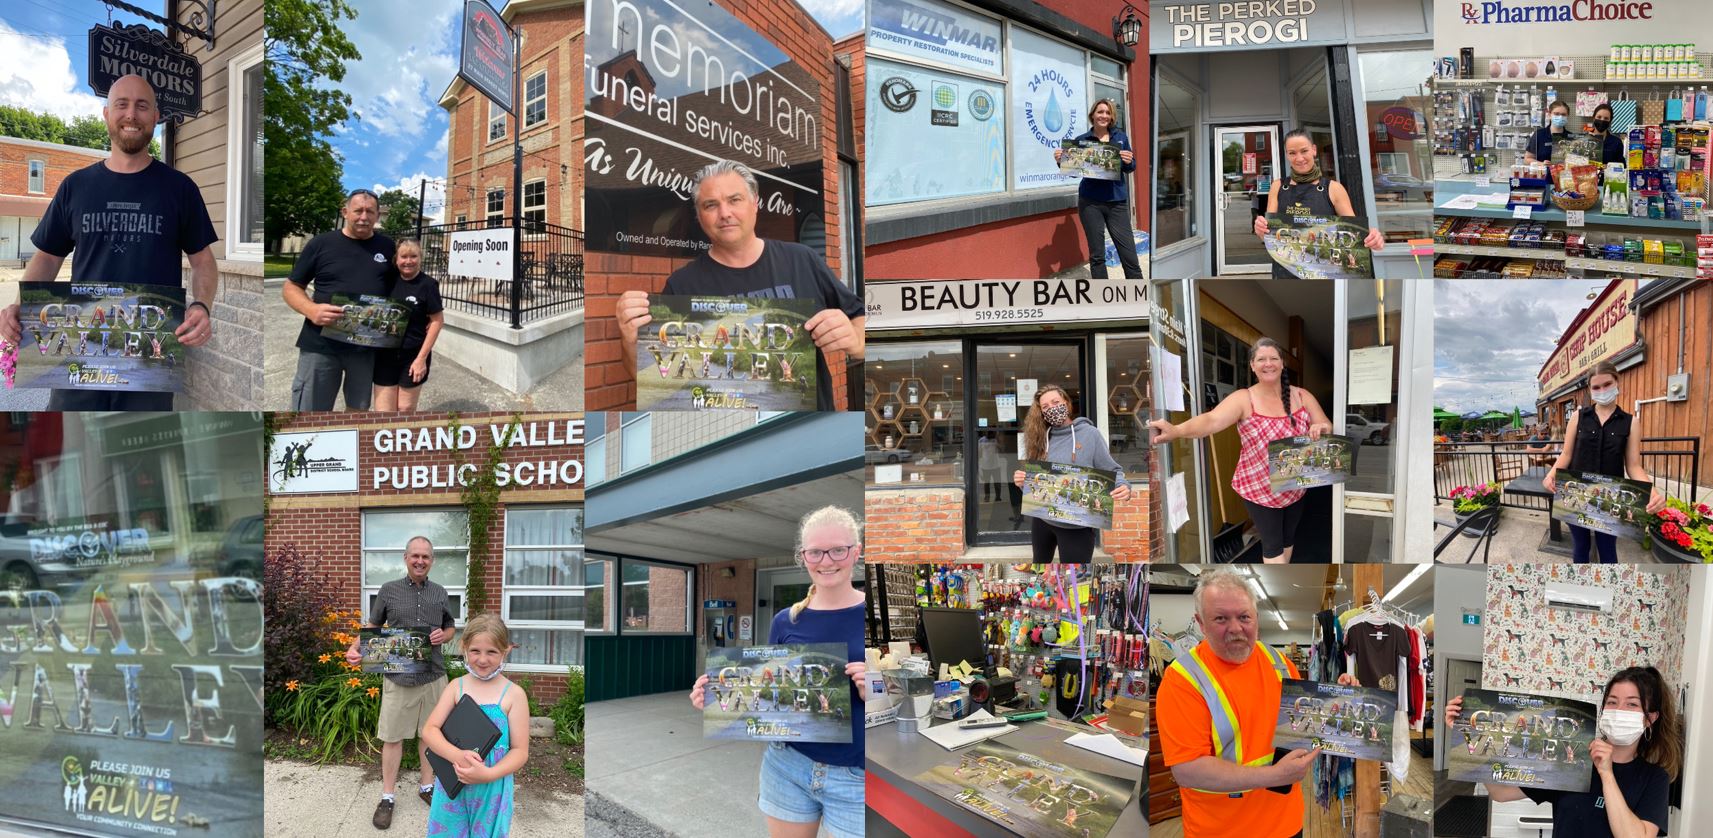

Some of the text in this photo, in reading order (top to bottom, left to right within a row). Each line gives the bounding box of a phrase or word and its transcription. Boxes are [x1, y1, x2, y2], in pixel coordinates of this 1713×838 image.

[1164, 0, 1316, 23] THE PERKED
[1481, 0, 1652, 24] PharmaChoice
[901, 9, 997, 52] WINMAR
[1173, 19, 1308, 47] PIEROGI
[101, 35, 194, 77] Silverdale
[870, 30, 994, 67] PROPERTY RESTORATION SPECIALISTS
[100, 55, 195, 96] MOTORS
[1028, 69, 1073, 98] 24 HOURS
[163, 92, 187, 106] South
[1025, 101, 1061, 149] EMERGENCY
[685, 110, 762, 157] services
[766, 137, 791, 169] inc.
[584, 137, 793, 216] As Uniqu Are
[1020, 173, 1069, 183] winmarorange
[82, 212, 163, 235] SILVERDALE
[453, 238, 508, 254] Opening Soon
[616, 231, 644, 244] Owned
[645, 236, 658, 245] and
[660, 236, 690, 248] Operated
[690, 240, 699, 250] by
[1276, 228, 1356, 248] GRAND
[71, 286, 124, 296] DISCOVER
[901, 279, 1148, 312] BEAUTY BAR ON M
[40, 303, 166, 330] GRAND
[691, 301, 748, 313] DISCOVER
[867, 304, 881, 312] BAR
[975, 309, 1044, 320] 519.928.5525
[1587, 290, 1627, 346] HOUSE
[33, 330, 172, 360] VALLEY
[659, 320, 796, 350] GRAND
[80, 372, 119, 384] ALIVE!
[651, 351, 803, 382] VALLEY
[705, 397, 746, 409] ALIVE!
[373, 420, 584, 453] GRAND VALLE
[373, 460, 583, 490] PUBLIC SCHO
[30, 528, 150, 562] DISCOVER
[76, 551, 155, 568] Nature's Playground
[743, 649, 788, 658] DISCOVER
[719, 663, 832, 688] GRAND
[712, 687, 839, 713] VALLEY
[1295, 696, 1381, 721] GRAND
[1499, 695, 1544, 707] DISCOVER
[757, 726, 790, 736] ALIVE!
[1289, 713, 1386, 741] VALLEY
[1470, 710, 1580, 738] GRAND
[1463, 733, 1585, 764] VALLEY
[90, 760, 171, 779] PLEASE JOIN US
[90, 773, 126, 786] VALLEY
[1502, 771, 1536, 782] ALIVE!
[87, 785, 180, 824] ALIVE!
[76, 813, 177, 836] YOUR COMMUNITY CONNECTION
